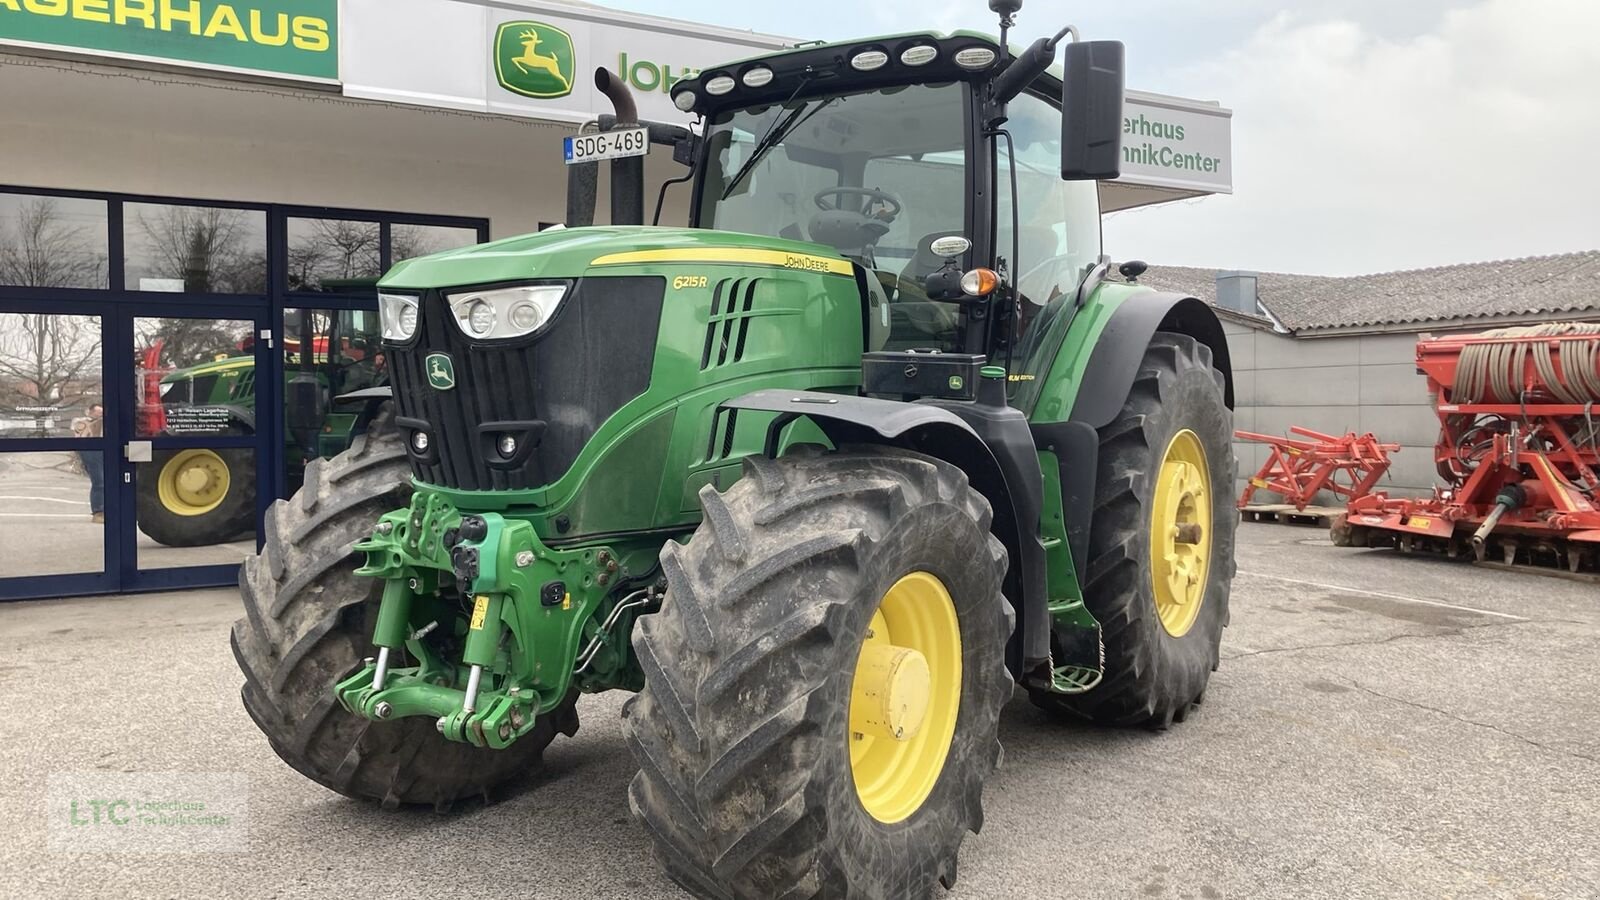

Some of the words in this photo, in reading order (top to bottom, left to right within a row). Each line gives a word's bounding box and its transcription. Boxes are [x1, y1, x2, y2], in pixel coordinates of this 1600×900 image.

[619, 52, 701, 93] JOH
[575, 131, 644, 157] SDG-469
[784, 254, 805, 268] JOHN
[805, 257, 829, 272] DEERE
